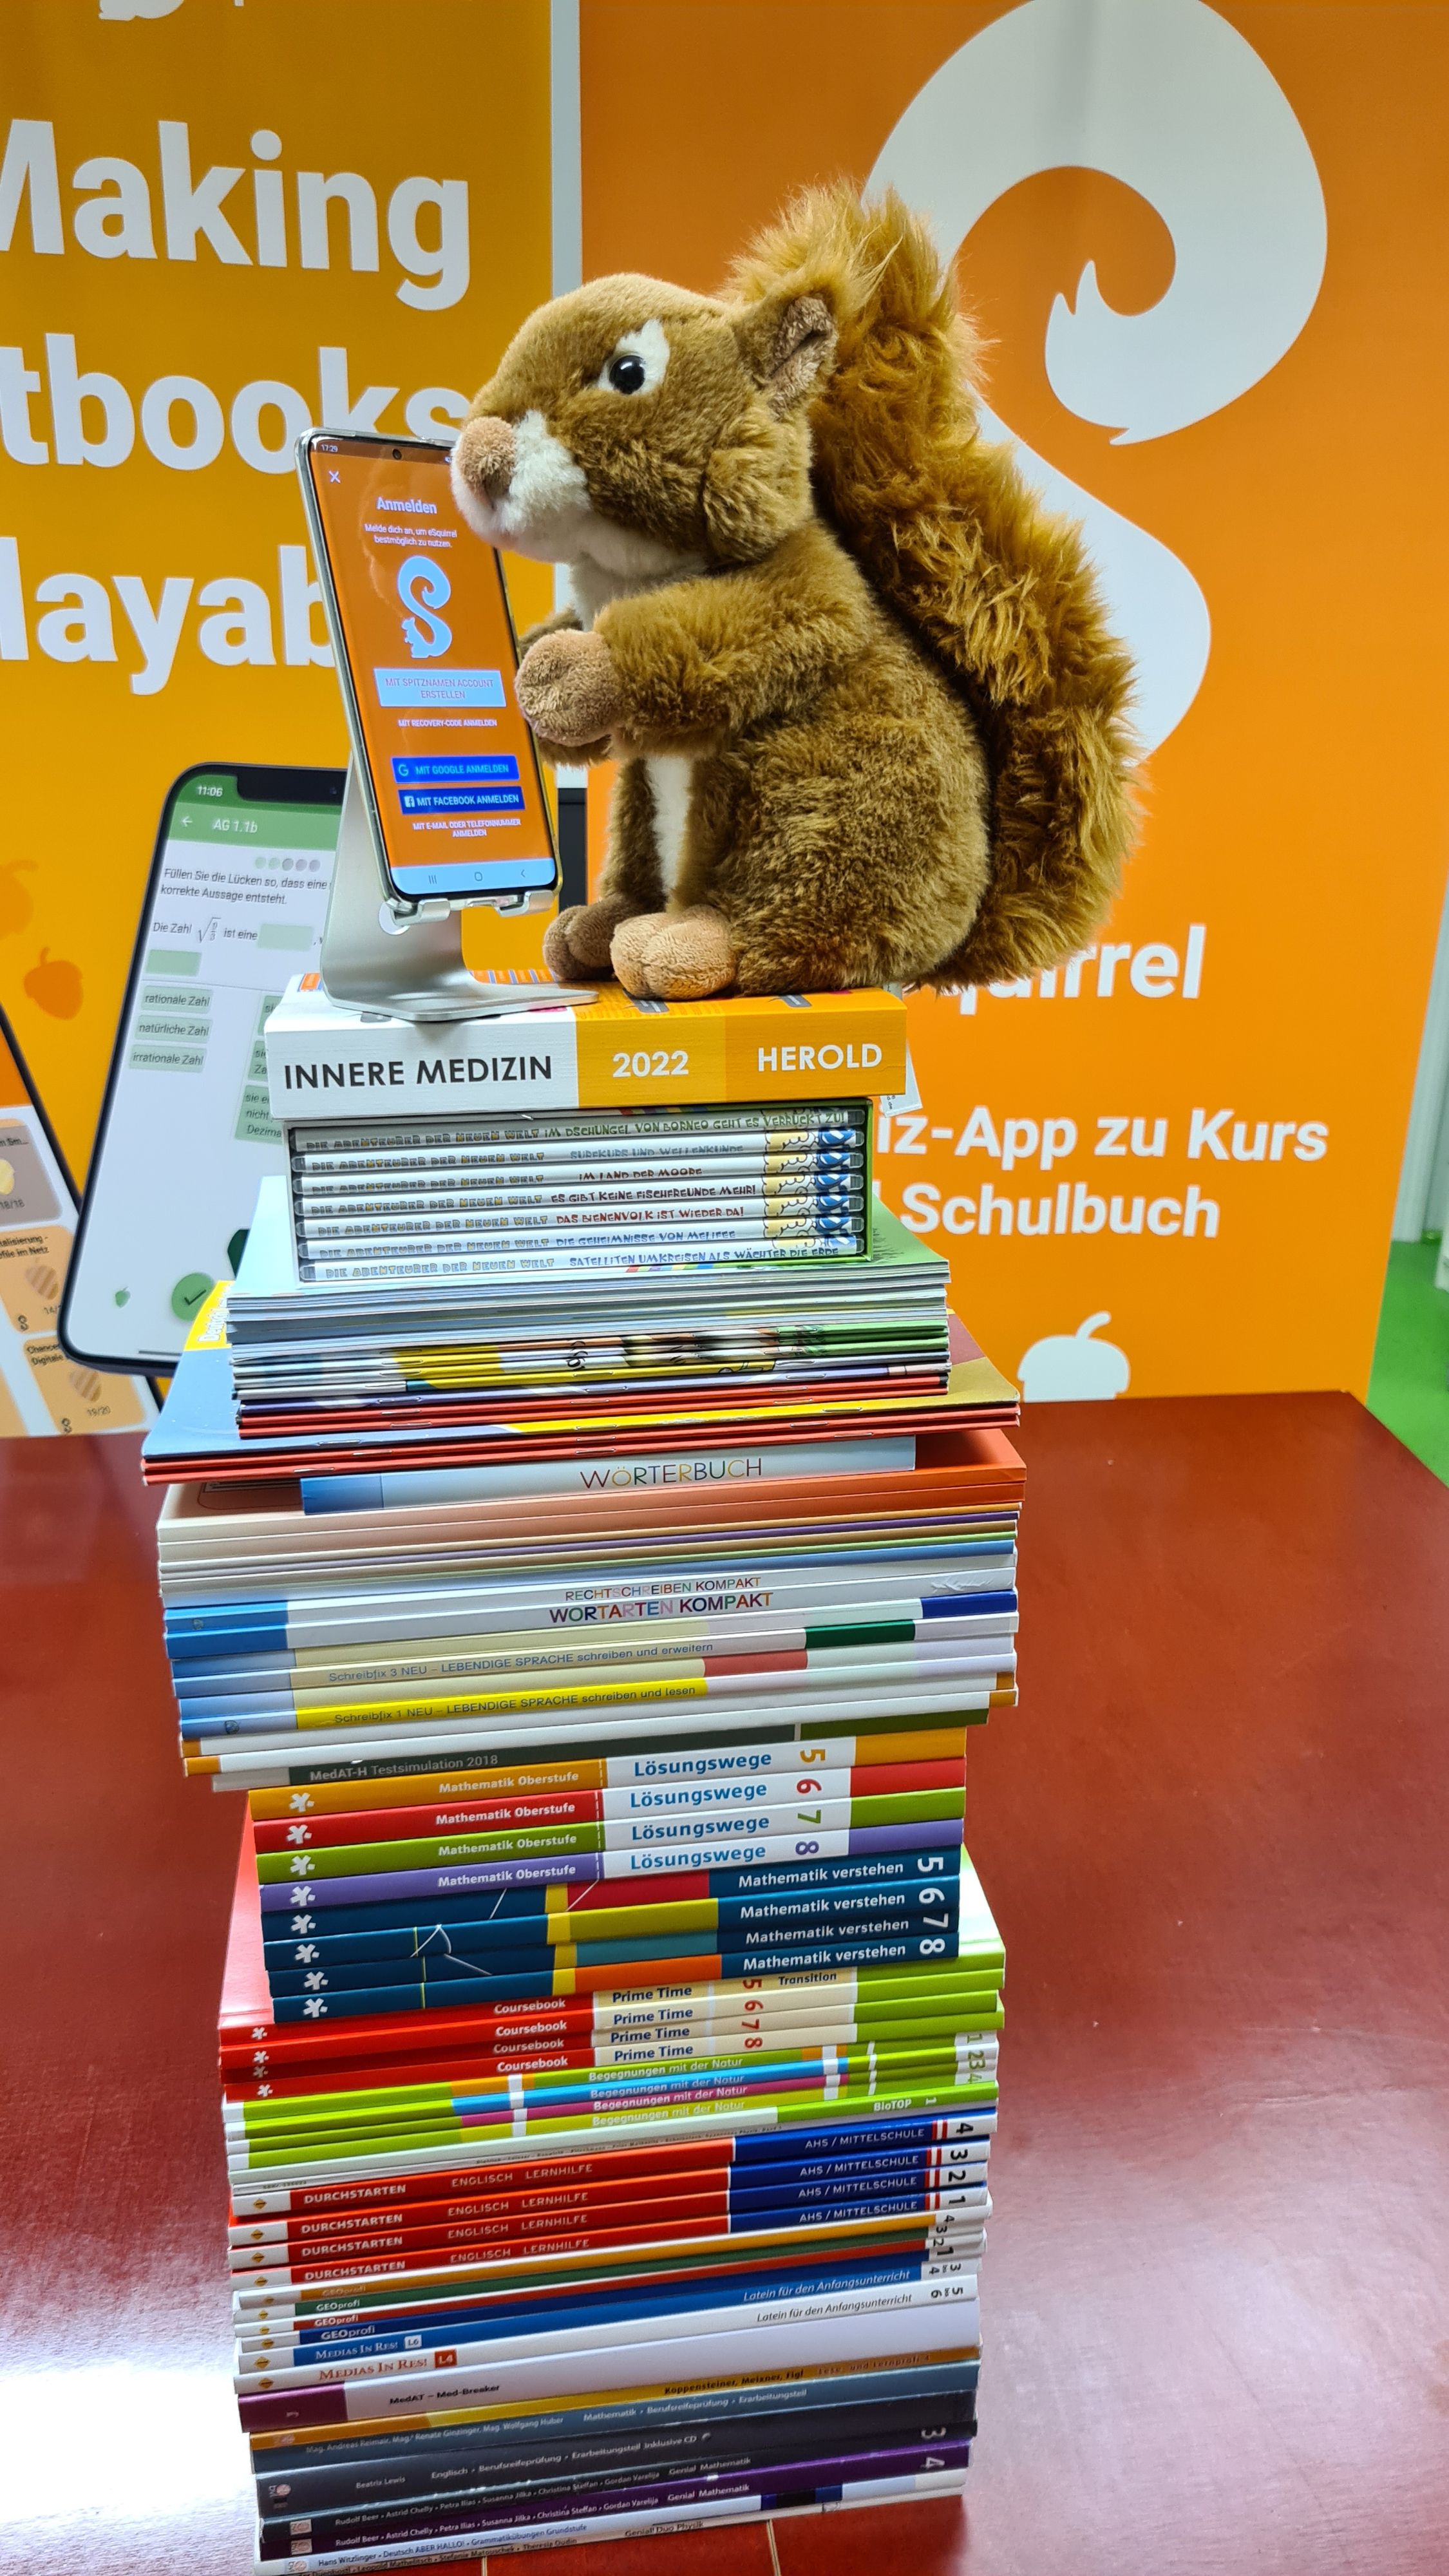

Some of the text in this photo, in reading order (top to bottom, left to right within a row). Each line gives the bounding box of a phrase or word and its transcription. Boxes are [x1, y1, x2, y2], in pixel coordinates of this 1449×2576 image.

[0, 118, 470, 311] Making
[321, 444, 337, 452] 17:29
[377, 497, 437, 514] Anmelden
[365, 524, 386, 533] Melde
[388, 525, 402, 534] dich
[404, 527, 415, 536] an,
[428, 529, 457, 538] eSquirrel
[374, 535, 416, 547] bestmöglich
[428, 539, 452, 547] nutzen.
[386, 678, 494, 688] MIT SPITZNAMEN ACCOUNT
[421, 690, 465, 699] ERSTELLEN
[415, 764, 509, 774] MIT GOOGLE ANMELDEN
[196, 786, 223, 797] 11:06
[417, 794, 519, 806] MIT FACEBOOK ANMELDEN
[213, 819, 258, 833] AG 1.1b
[164, 868, 328, 890] Füllen Sie die Lücken so, dass eine
[160, 884, 287, 905] korrekte Aussage entsteht.
[153, 922, 258, 940] Die Zahl ist eine
[145, 995, 210, 1007] rationale Zahl
[139, 1024, 209, 1036] natürliche Zahl
[132, 1052, 204, 1065] irrationale Zahl
[284, 1043, 882, 1089] INNERE MEDIZIN 2022 HEROLD
[1094, 1116, 1169, 1158] zu
[1188, 1108, 1329, 1162] Kurs
[311, 1206, 334, 1216] DIE
[338, 1200, 424, 1214] ABENTEURER
[430, 1198, 455, 1210] DER
[459, 1196, 503, 1208] NEUEN
[507, 1195, 542, 1206] WELT
[551, 1194, 566, 1204] ES
[899, 1181, 1220, 1238] Schulbuch
[580, 1457, 762, 1489] WÖRTERBUCH
[565, 1577, 761, 1601] RECHTSCHREIBEN KOMPAKT
[549, 1592, 773, 1623] WORTARTEN KOMPAKT
[335, 1710, 392, 1723] Schreibfix
[407, 1707, 432, 1717] NEU
[447, 1700, 516, 1714] LEBENDIGE
[521, 1694, 578, 1708] SPRACHE
[582, 1690, 636, 1703] schreiben
[641, 1689, 661, 1698] und
[666, 1686, 695, 1696] lesen
[310, 1755, 498, 1782] MedAT-H Testsimulation 2018
[439, 1748, 826, 1793] Mathematik Oberstufe Lösungswege 5
[435, 1778, 822, 1824] Mathematik Oberstufe Lösungswege 6
[439, 1810, 821, 1856] Mathematik Oberstufe Lösungswege 7
[438, 1841, 820, 1887] Mathematik Oberstufe Lösungswege 8
[739, 1857, 944, 1888] Mathematik verstehen 5
[740, 1888, 945, 1918] Mathematik verstehen 6
[745, 1913, 949, 1945] Mathematik verstehen 7
[743, 1938, 946, 1971] Mathematik verstehen 8
[494, 1973, 837, 2014] Coursebook Prime Time 5 Transition
[497, 2038, 762, 2072] Coursebook Prime Time 8
[589, 2058, 743, 2081] Begegnungen mit der Natur
[874, 2098, 912, 2112] BioTOP
[303, 2184, 406, 2204] DURCHSTARTEN
[451, 2172, 513, 2188] ENGLISCH
[525, 2163, 592, 2181] LERNHILFE
[805, 2139, 828, 2149] AHS
[840, 2128, 925, 2145] MITTELSCHULE
[956, 2123, 974, 2134] 4
[300, 2213, 403, 2234] DURCHSTARTEN
[448, 2201, 509, 2217] ENGLISCH
[522, 2192, 588, 2208] LERNHILFE
[800, 2166, 823, 2177] AHS
[835, 2155, 919, 2172] MITTELSCHULE
[950, 2148, 968, 2160] 3
[757, 2294, 912, 2322] Latein für den Anfangsunterricht
[321, 2325, 375, 2340] GEOprofi
[438, 2354, 453, 2364] L4
[390, 2394, 424, 2405] MedAT
[437, 2385, 500, 2399] Med-Breaker
